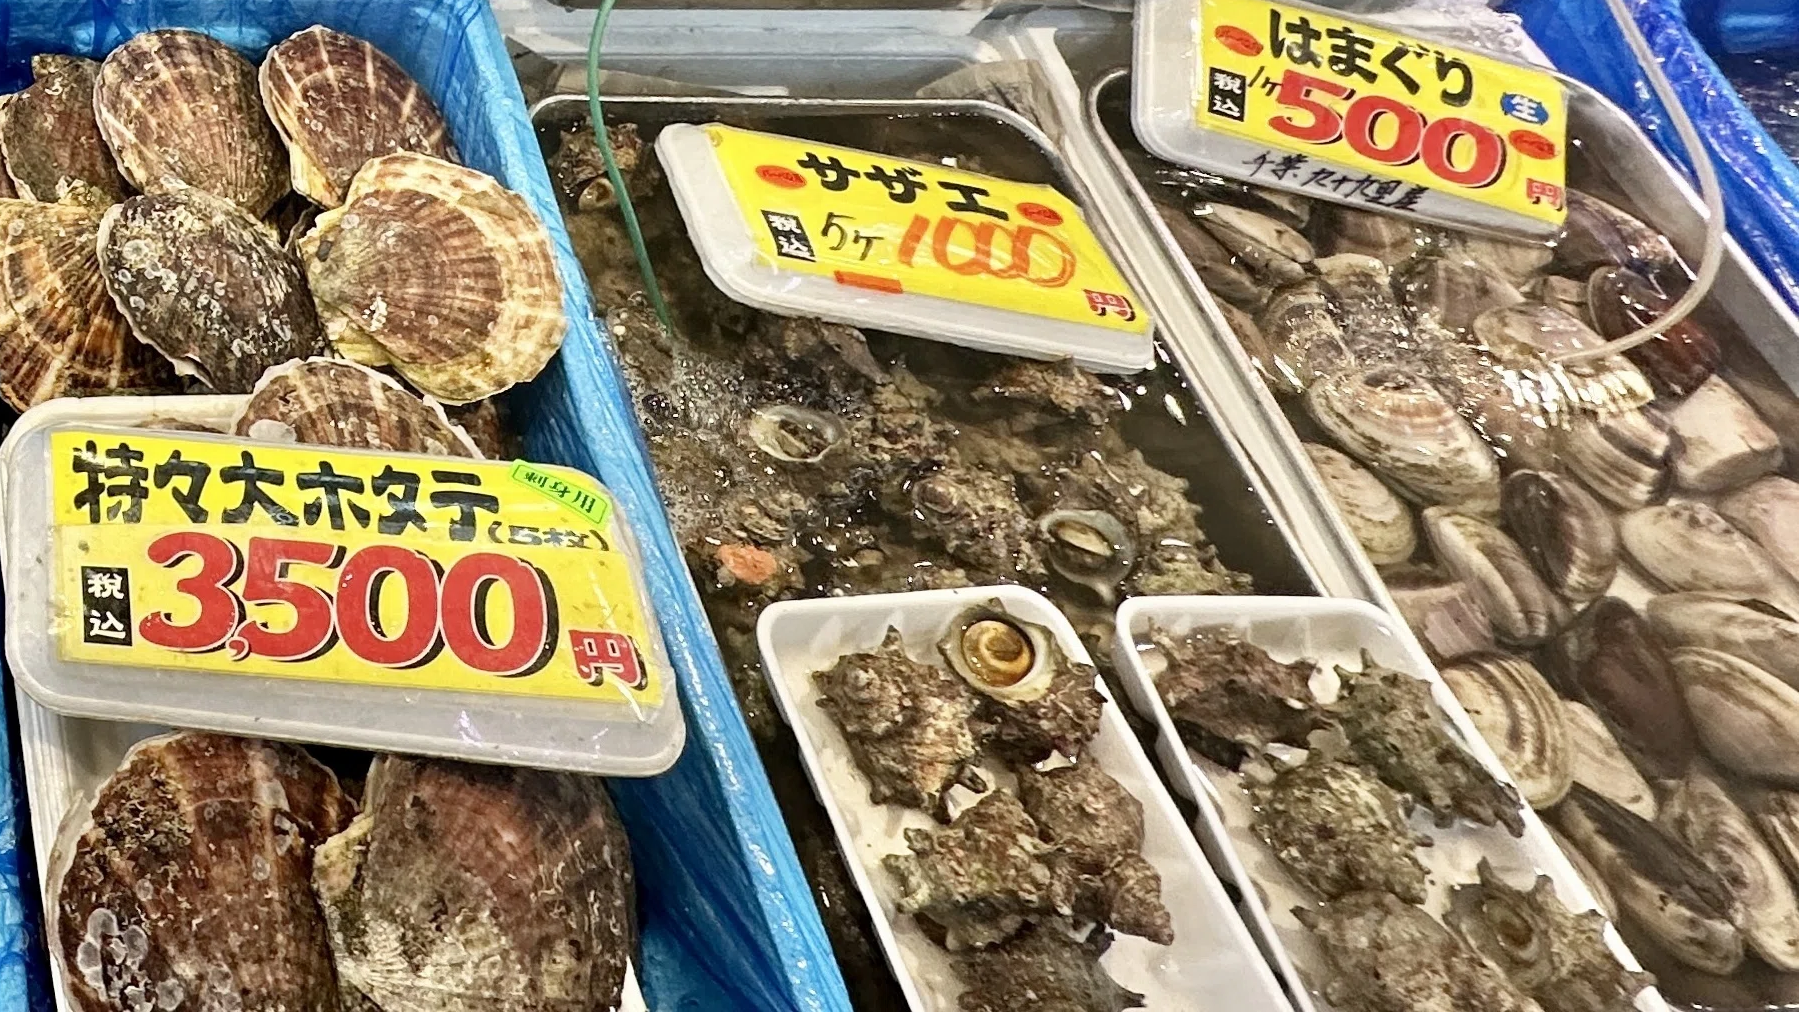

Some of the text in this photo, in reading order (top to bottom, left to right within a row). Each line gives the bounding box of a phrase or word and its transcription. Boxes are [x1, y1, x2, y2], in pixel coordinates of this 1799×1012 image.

[1269, 8, 1473, 107] はまぐり
[1213, 72, 1245, 118] 税込
[1511, 95, 1540, 122] 生
[797, 151, 1010, 221] サザエ
[767, 214, 811, 257] 税込
[897, 214, 1077, 288] 1000
[1083, 289, 1136, 321] 円
[73, 439, 500, 541] 特々大ホタテ
[522, 468, 598, 514] 刺身用
[87, 571, 128, 641] 税込
